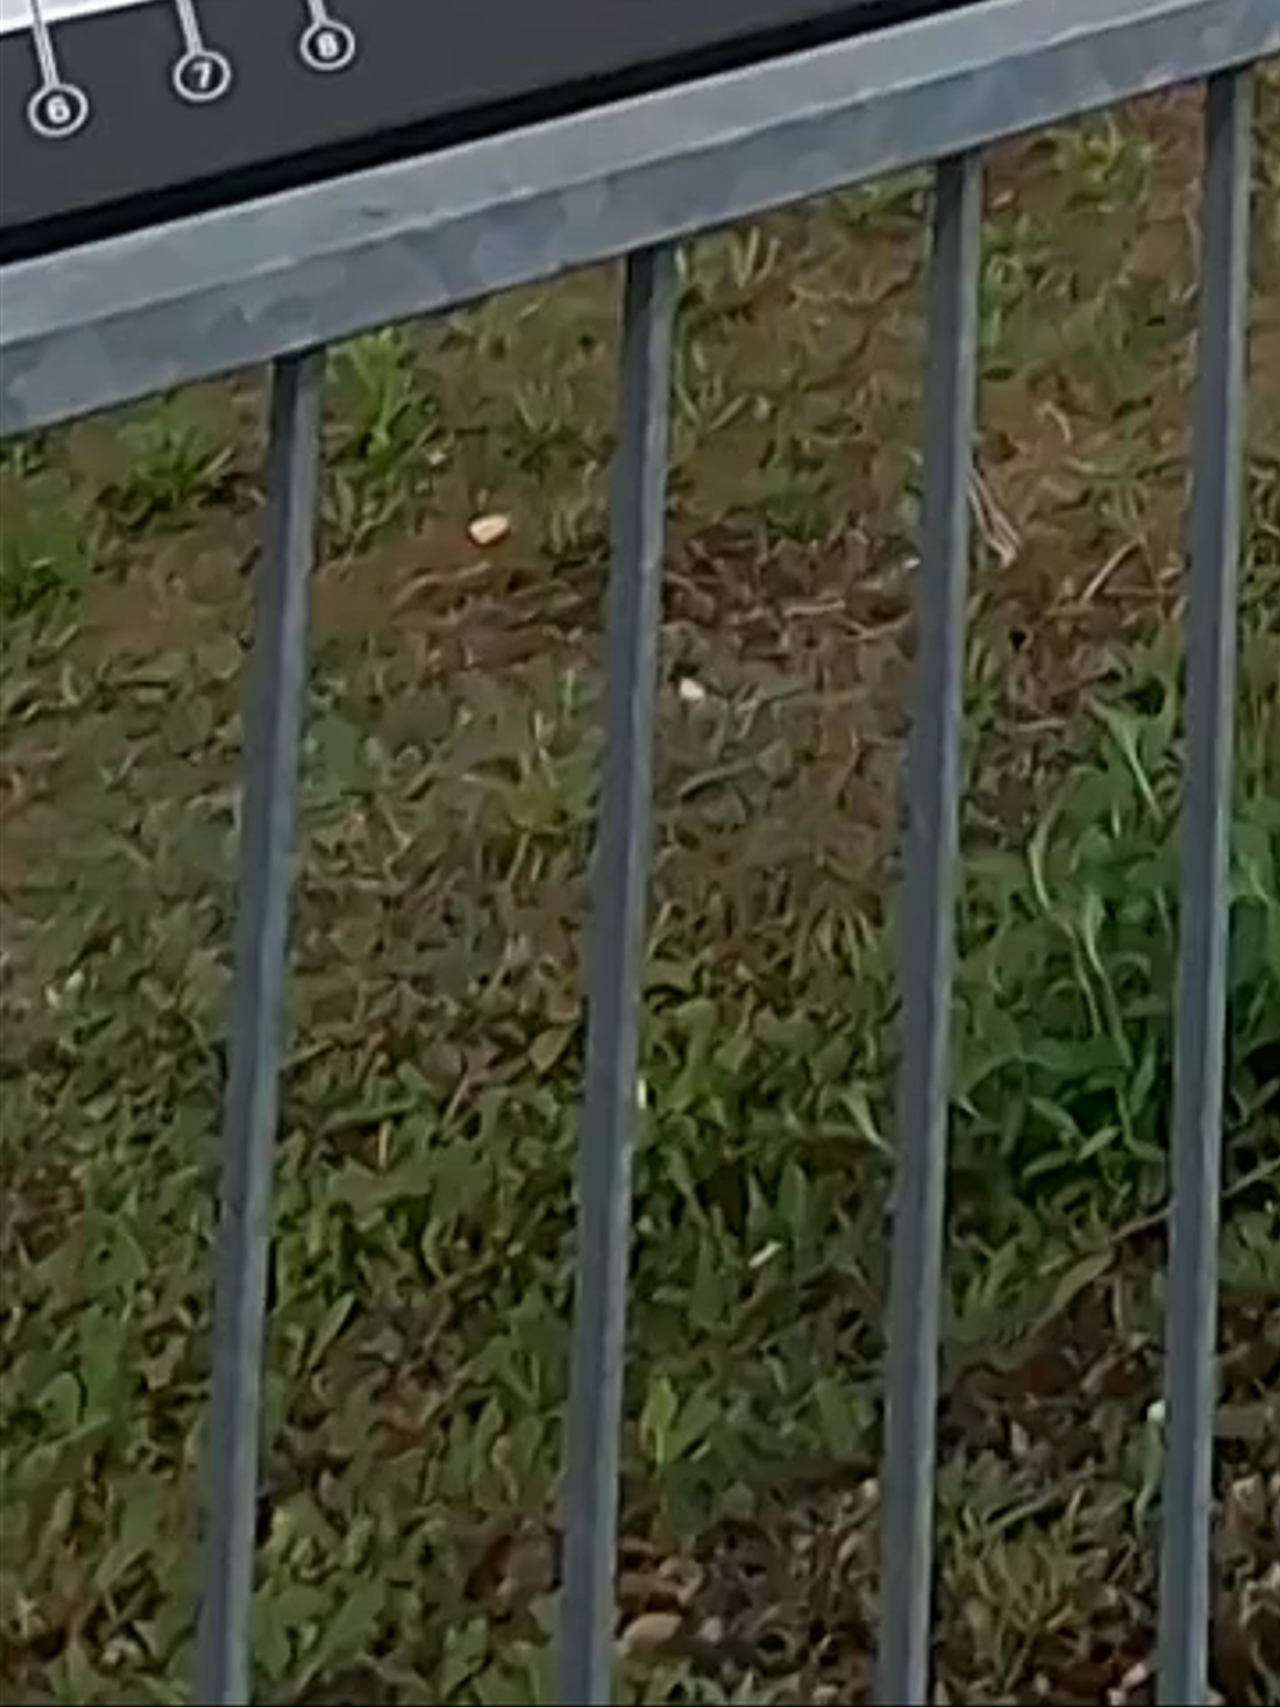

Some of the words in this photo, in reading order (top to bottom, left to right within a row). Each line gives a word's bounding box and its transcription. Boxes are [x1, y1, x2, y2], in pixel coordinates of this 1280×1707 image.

[317, 31, 339, 59] 8
[193, 61, 212, 89] 7
[46, 94, 71, 124] 6
